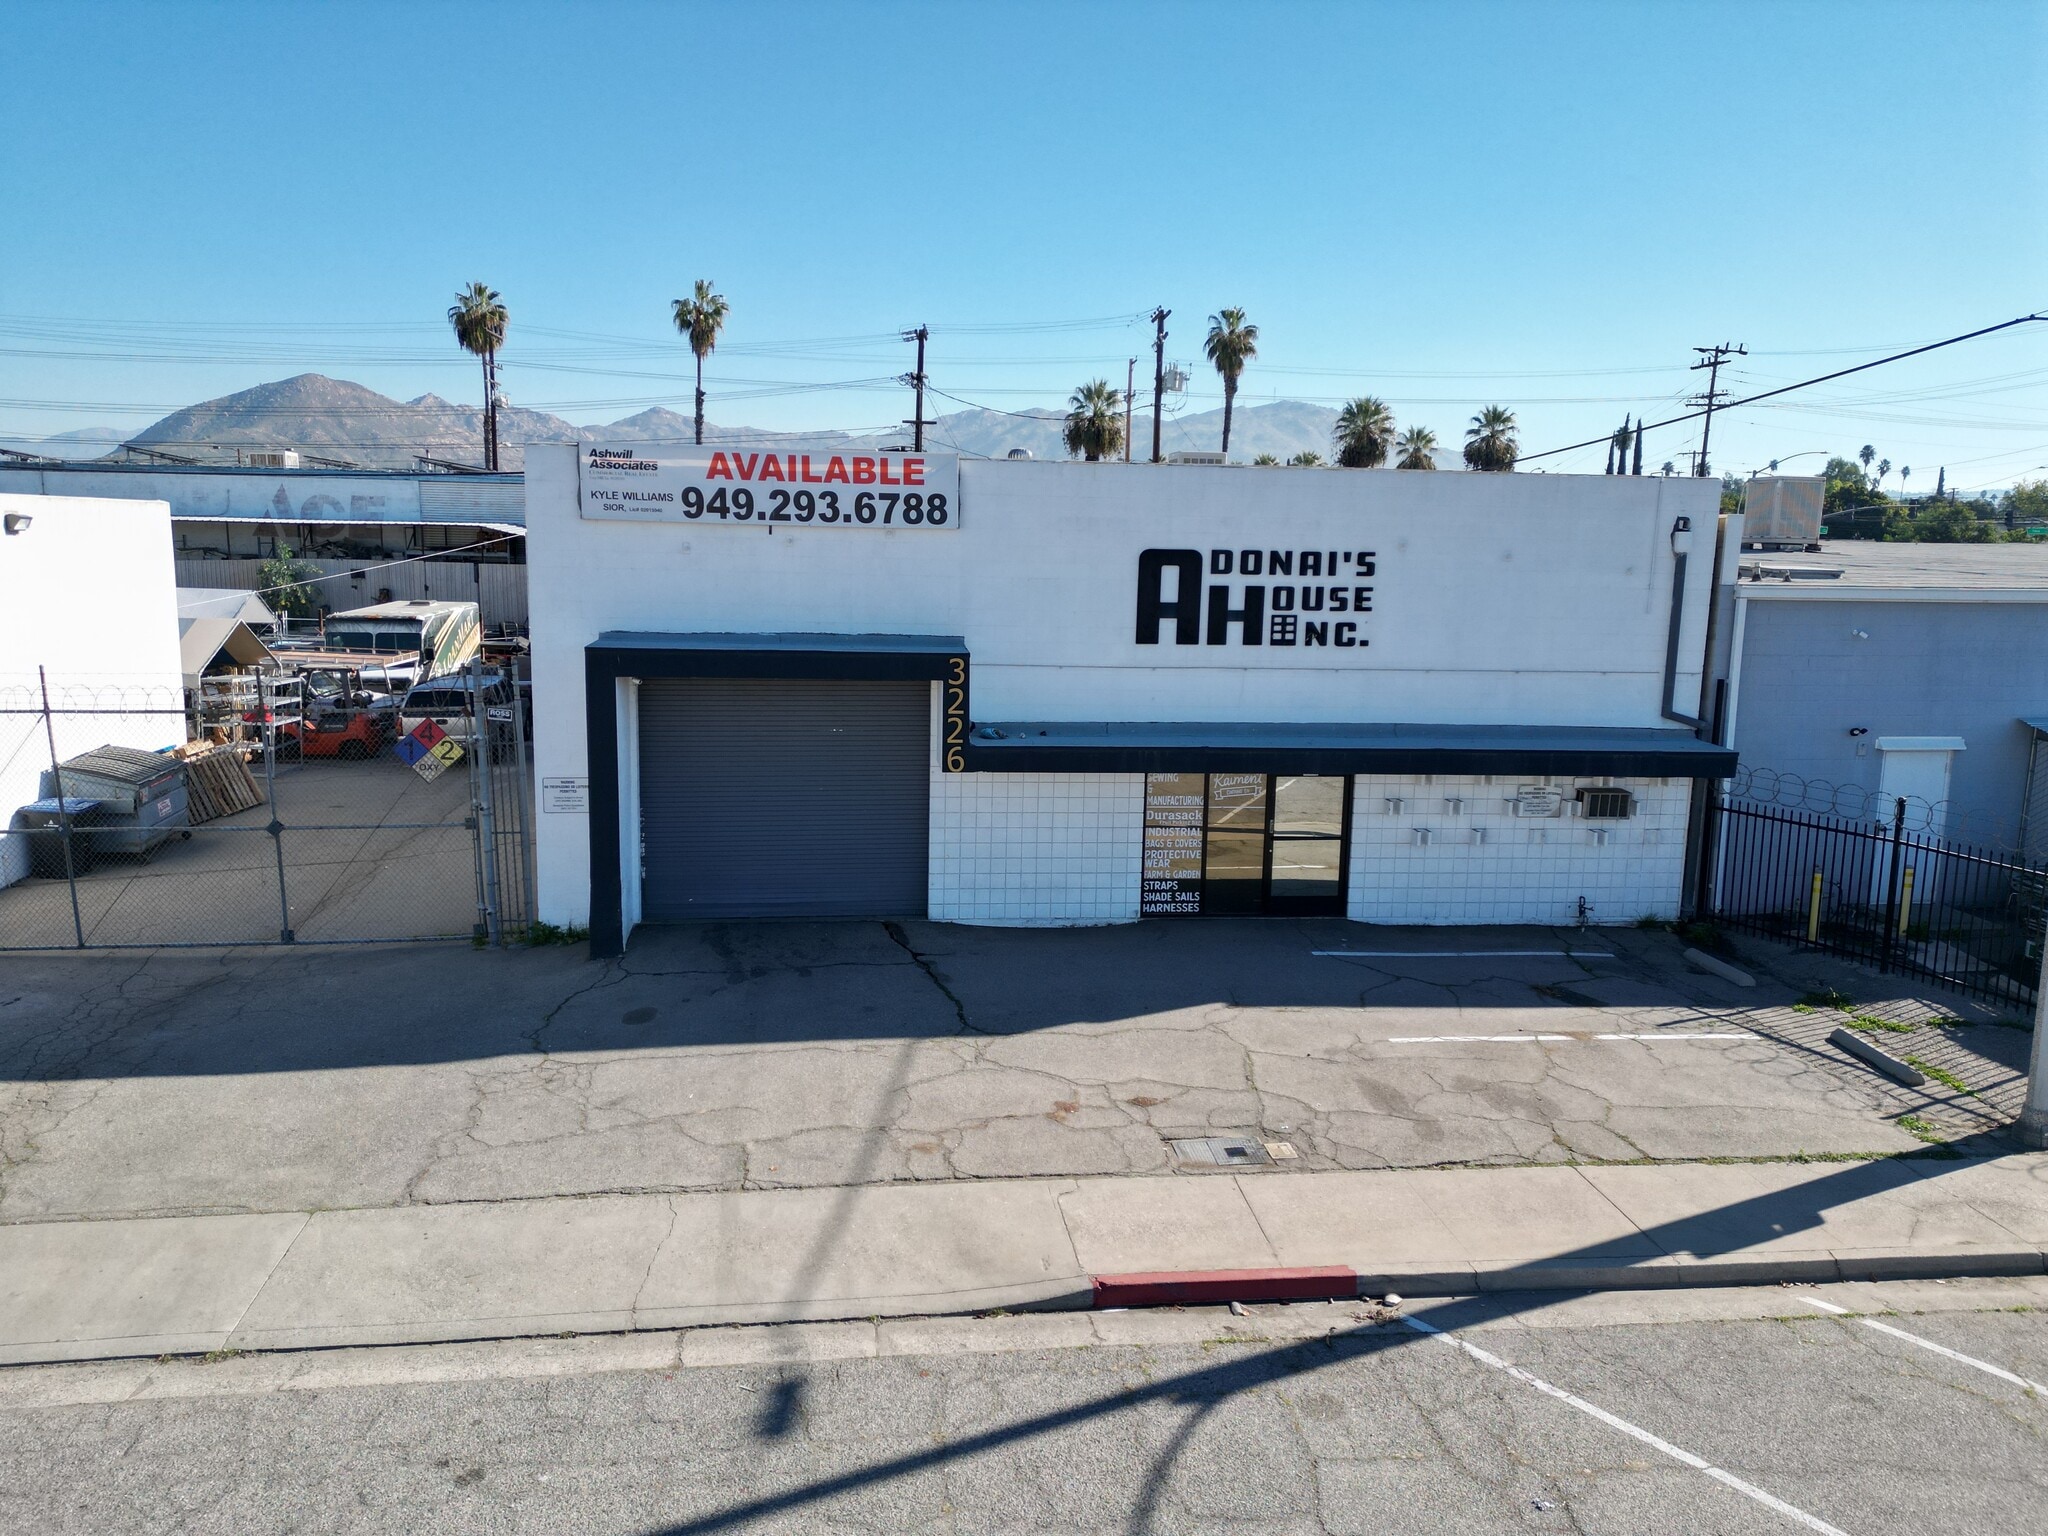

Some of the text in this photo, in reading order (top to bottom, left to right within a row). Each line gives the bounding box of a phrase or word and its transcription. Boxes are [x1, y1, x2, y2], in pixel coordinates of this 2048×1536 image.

[589, 448, 633, 459] Ashwill
[589, 459, 658, 471] Associates
[706, 451, 925, 485] AVAILABLE
[590, 490, 674, 502] KYLE WILLIAMS
[252, 482, 385, 538] ACE
[603, 503, 627, 512] SIOR,
[681, 486, 949, 526] 949.293.6788
[490, 709, 510, 717] ROSS
[946, 657, 965, 773] 3226
[419, 723, 434, 742] 4
[404, 740, 455, 760] 1 2
[1147, 773, 1178, 783] SEWING
[1147, 796, 1204, 806] MANUFACTURING
[1146, 810, 1203, 820] Durasack
[1146, 828, 1202, 837] INDUSTRIAL
[1145, 839, 1202, 848] BAGS & COVERS
[1145, 850, 1201, 859] PROTECTIVE
[1145, 859, 1170, 868] WEAR
[1144, 870, 1201, 879] FARM & GARDEN
[1144, 881, 1178, 891] STRAPS
[1144, 892, 1200, 902] SHADE SAILS
[1143, 903, 1199, 913] HARNESSES
